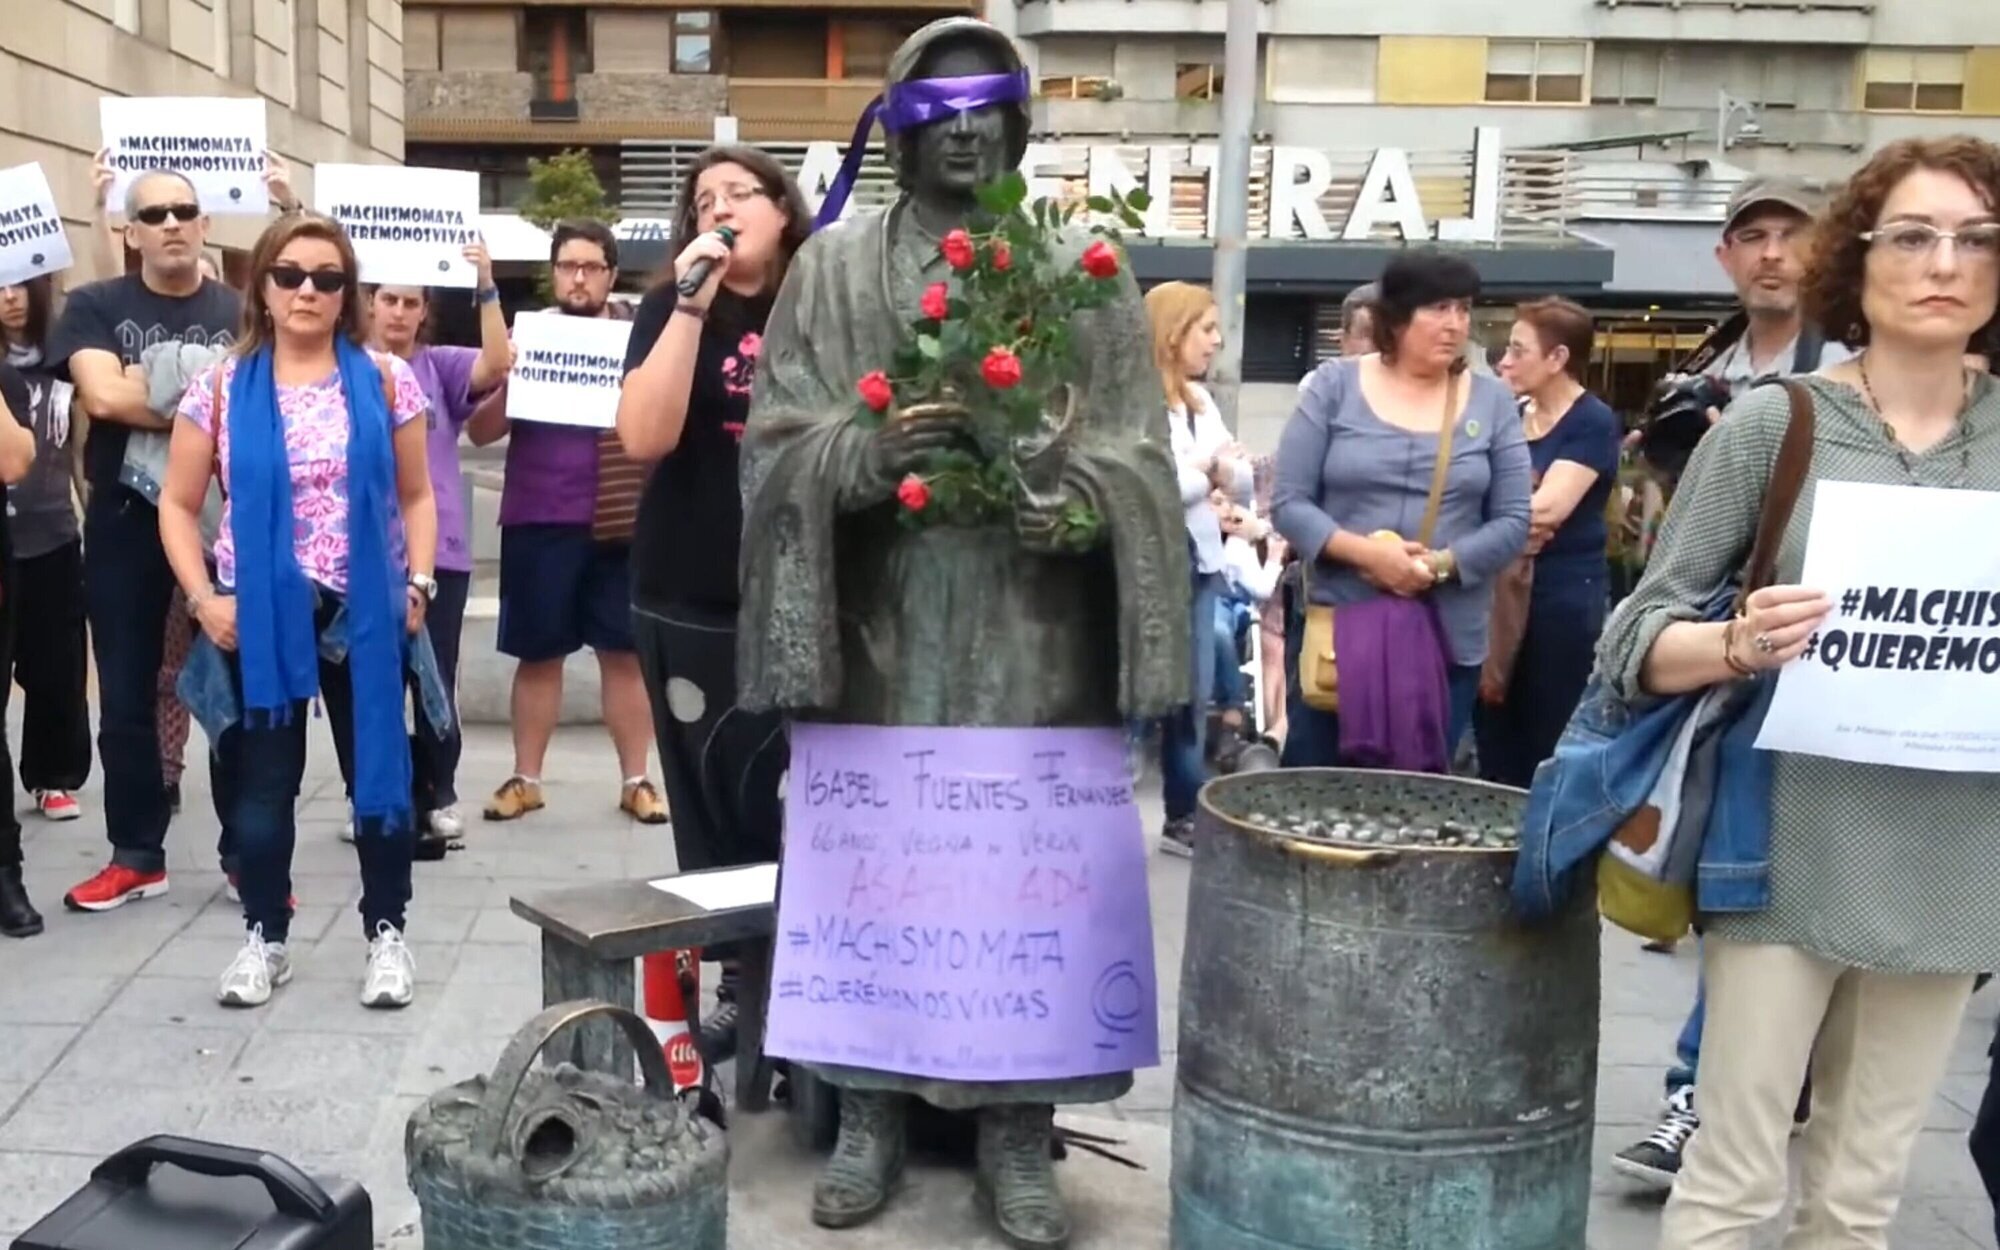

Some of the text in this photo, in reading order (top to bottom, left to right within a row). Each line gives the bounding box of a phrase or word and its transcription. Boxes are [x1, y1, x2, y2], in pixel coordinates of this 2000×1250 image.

[119, 136, 253, 154] #MACHISMOMATA
[1018, 126, 1501, 243] ENTRAL
[331, 203, 465, 225] #MACHISMOMATA
[525, 349, 624, 371] #MACHISMOM
[804, 750, 889, 809] ISABEL
[903, 750, 1029, 811] FUENTES
